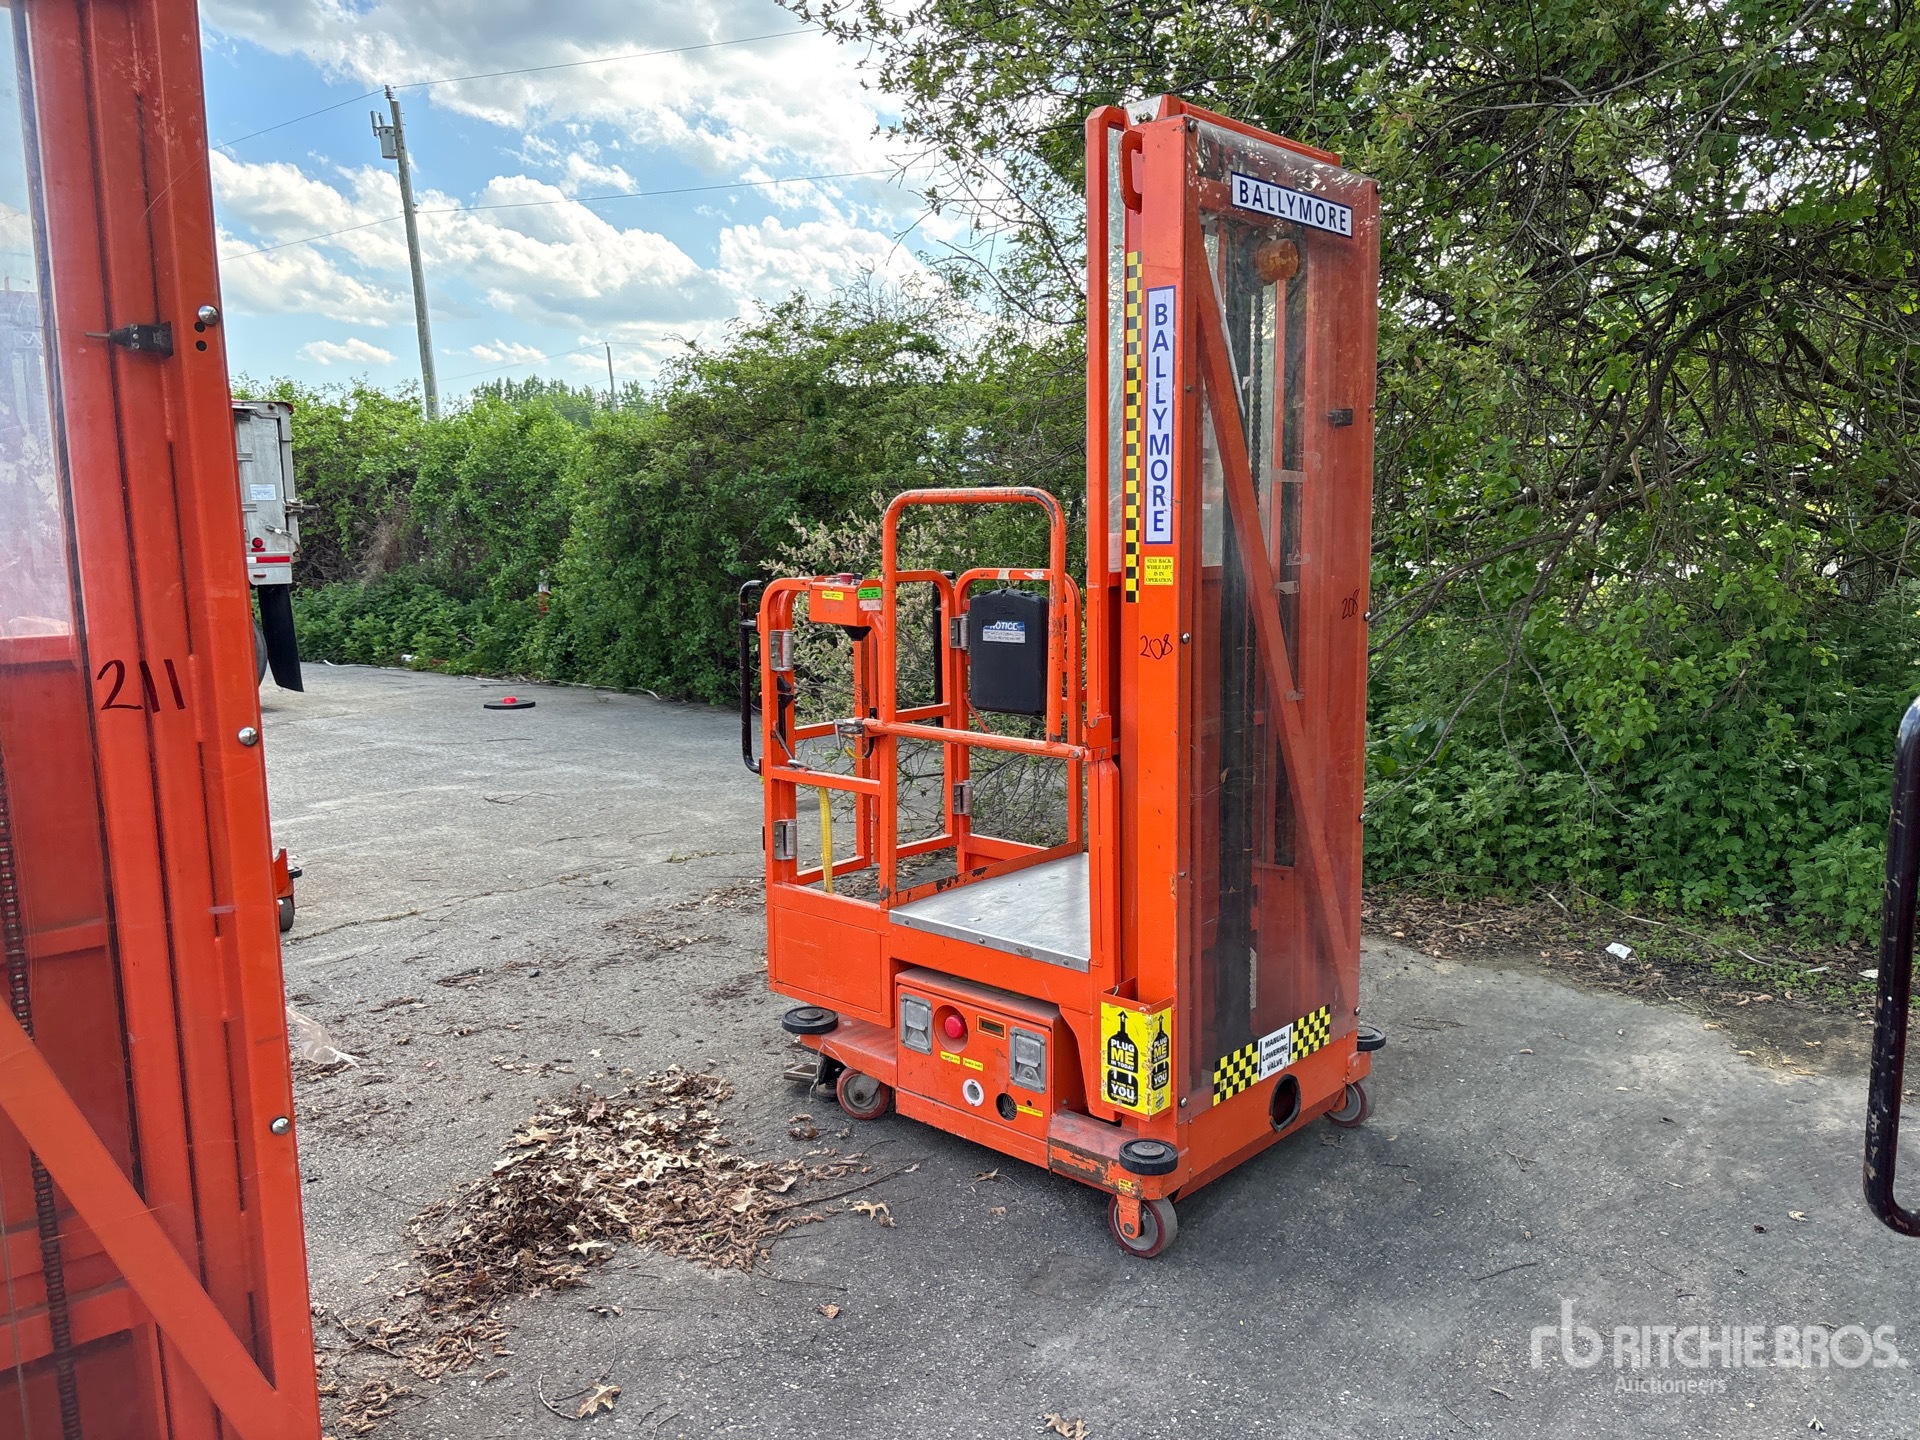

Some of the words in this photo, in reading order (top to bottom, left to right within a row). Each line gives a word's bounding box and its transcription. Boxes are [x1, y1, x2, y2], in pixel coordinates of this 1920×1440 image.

[1239, 180, 1347, 232] BALLYMORE
[1149, 303, 1170, 532] BALLYMORE
[1139, 633, 1173, 660] 208
[96, 659, 186, 713] 211
[1110, 1038, 1135, 1052] PLUG
[1153, 1036, 1167, 1048] PLUG
[1264, 1032, 1287, 1048] MANUAL
[1110, 1046, 1135, 1066] ME
[1153, 1043, 1167, 1058] ME
[1262, 1043, 1289, 1062] LOWERING
[1117, 1061, 1135, 1071] TODAY
[1266, 1057, 1283, 1071] VALVE
[1153, 1072, 1167, 1085] YOU
[1110, 1083, 1135, 1099] YOU
